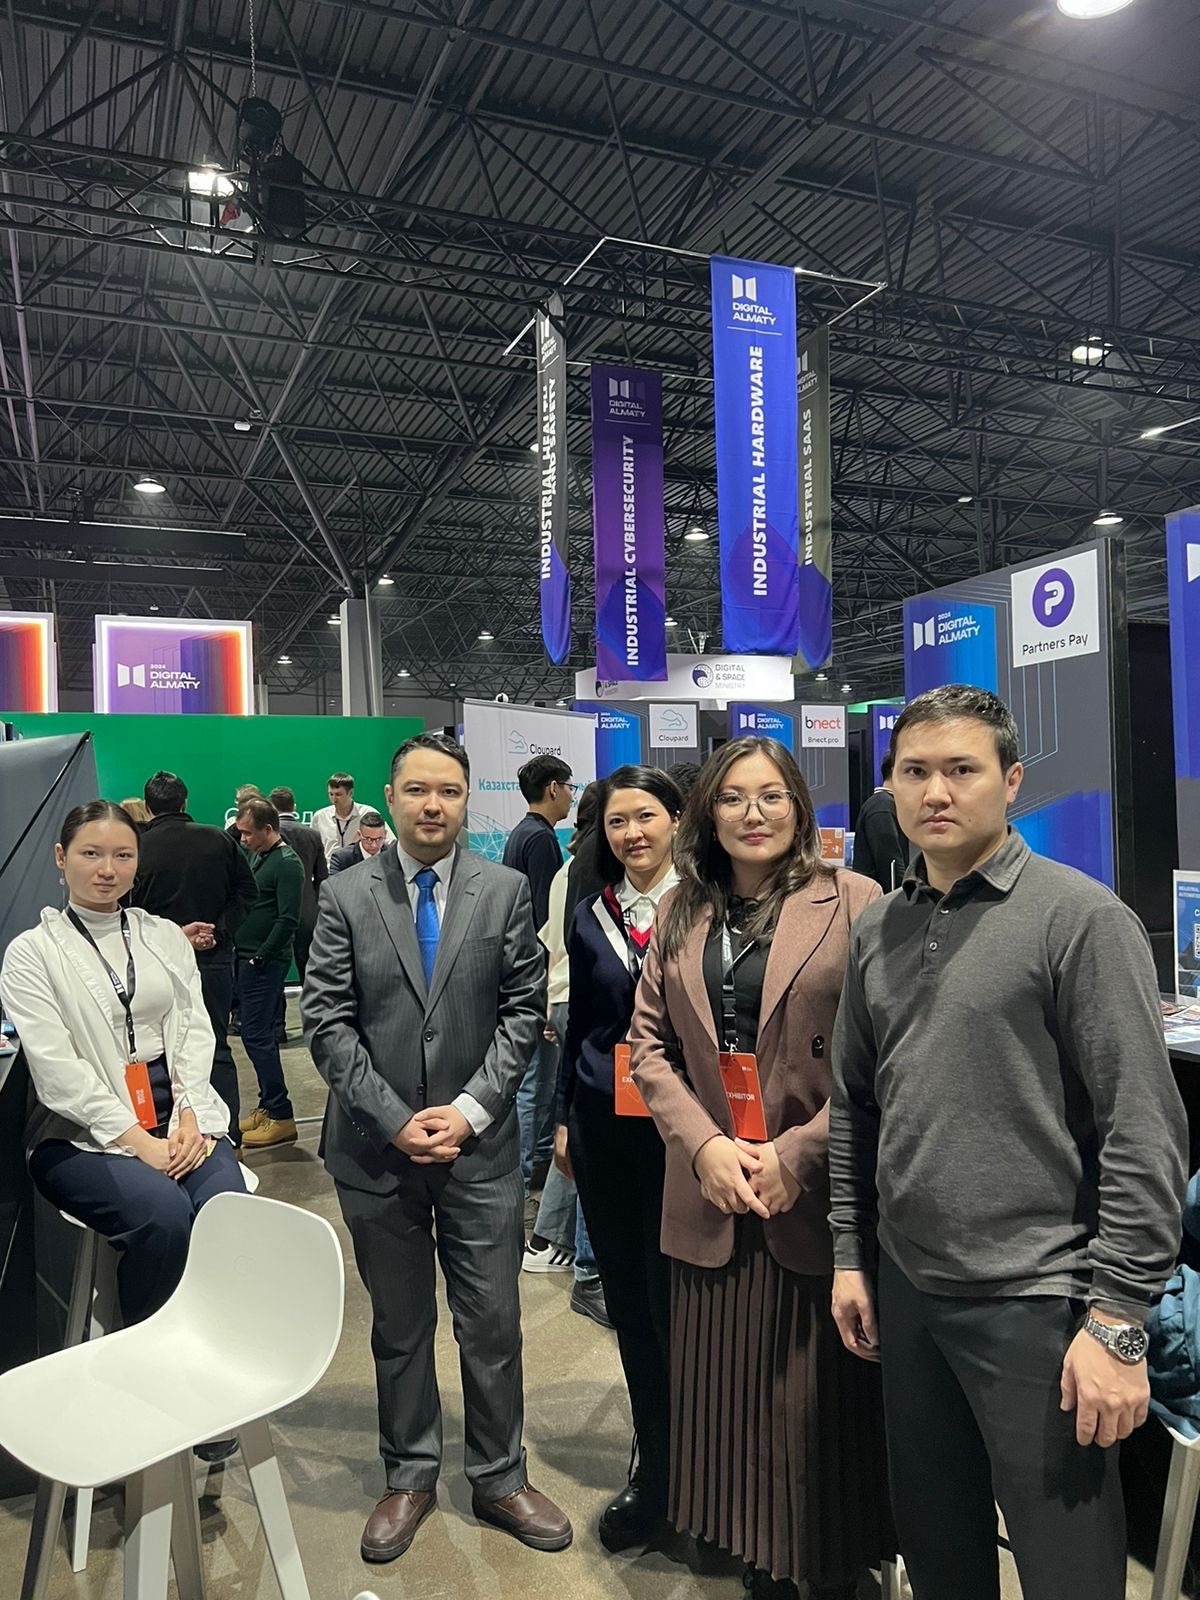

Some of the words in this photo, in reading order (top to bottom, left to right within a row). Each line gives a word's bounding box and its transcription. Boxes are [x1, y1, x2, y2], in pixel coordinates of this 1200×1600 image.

[733, 302, 773, 316] DIGITAL
[733, 312, 776, 325] ALMATY
[609, 400, 643, 410] DIGITAL
[749, 346, 766, 467] HARDWARE
[609, 408, 646, 417] ALMATY
[802, 408, 812, 455] SAAS
[622, 435, 637, 564] CYBERSECURITY
[803, 459, 814, 566] INDUSTRIAL
[541, 469, 553, 579] INDUSTRIAL
[752, 473, 768, 596] INDUSTRIAL
[624, 567, 639, 666] INDUSTRIAL
[938, 615, 976, 633] DIGITAL
[938, 625, 980, 645] ALMATY
[1022, 638, 1066, 655] Partners
[1069, 634, 1088, 646] Pay
[715, 664, 746, 672] DIGITAL
[150, 671, 196, 680] DIGITAL
[722, 673, 745, 681] SPACE
[150, 681, 200, 689] ALMATY
[805, 716, 841, 729] bnect
[658, 734, 688, 742] Cloupard
[478, 778, 520, 791] Казахста
[727, 1091, 756, 1101] XHIBITOR
